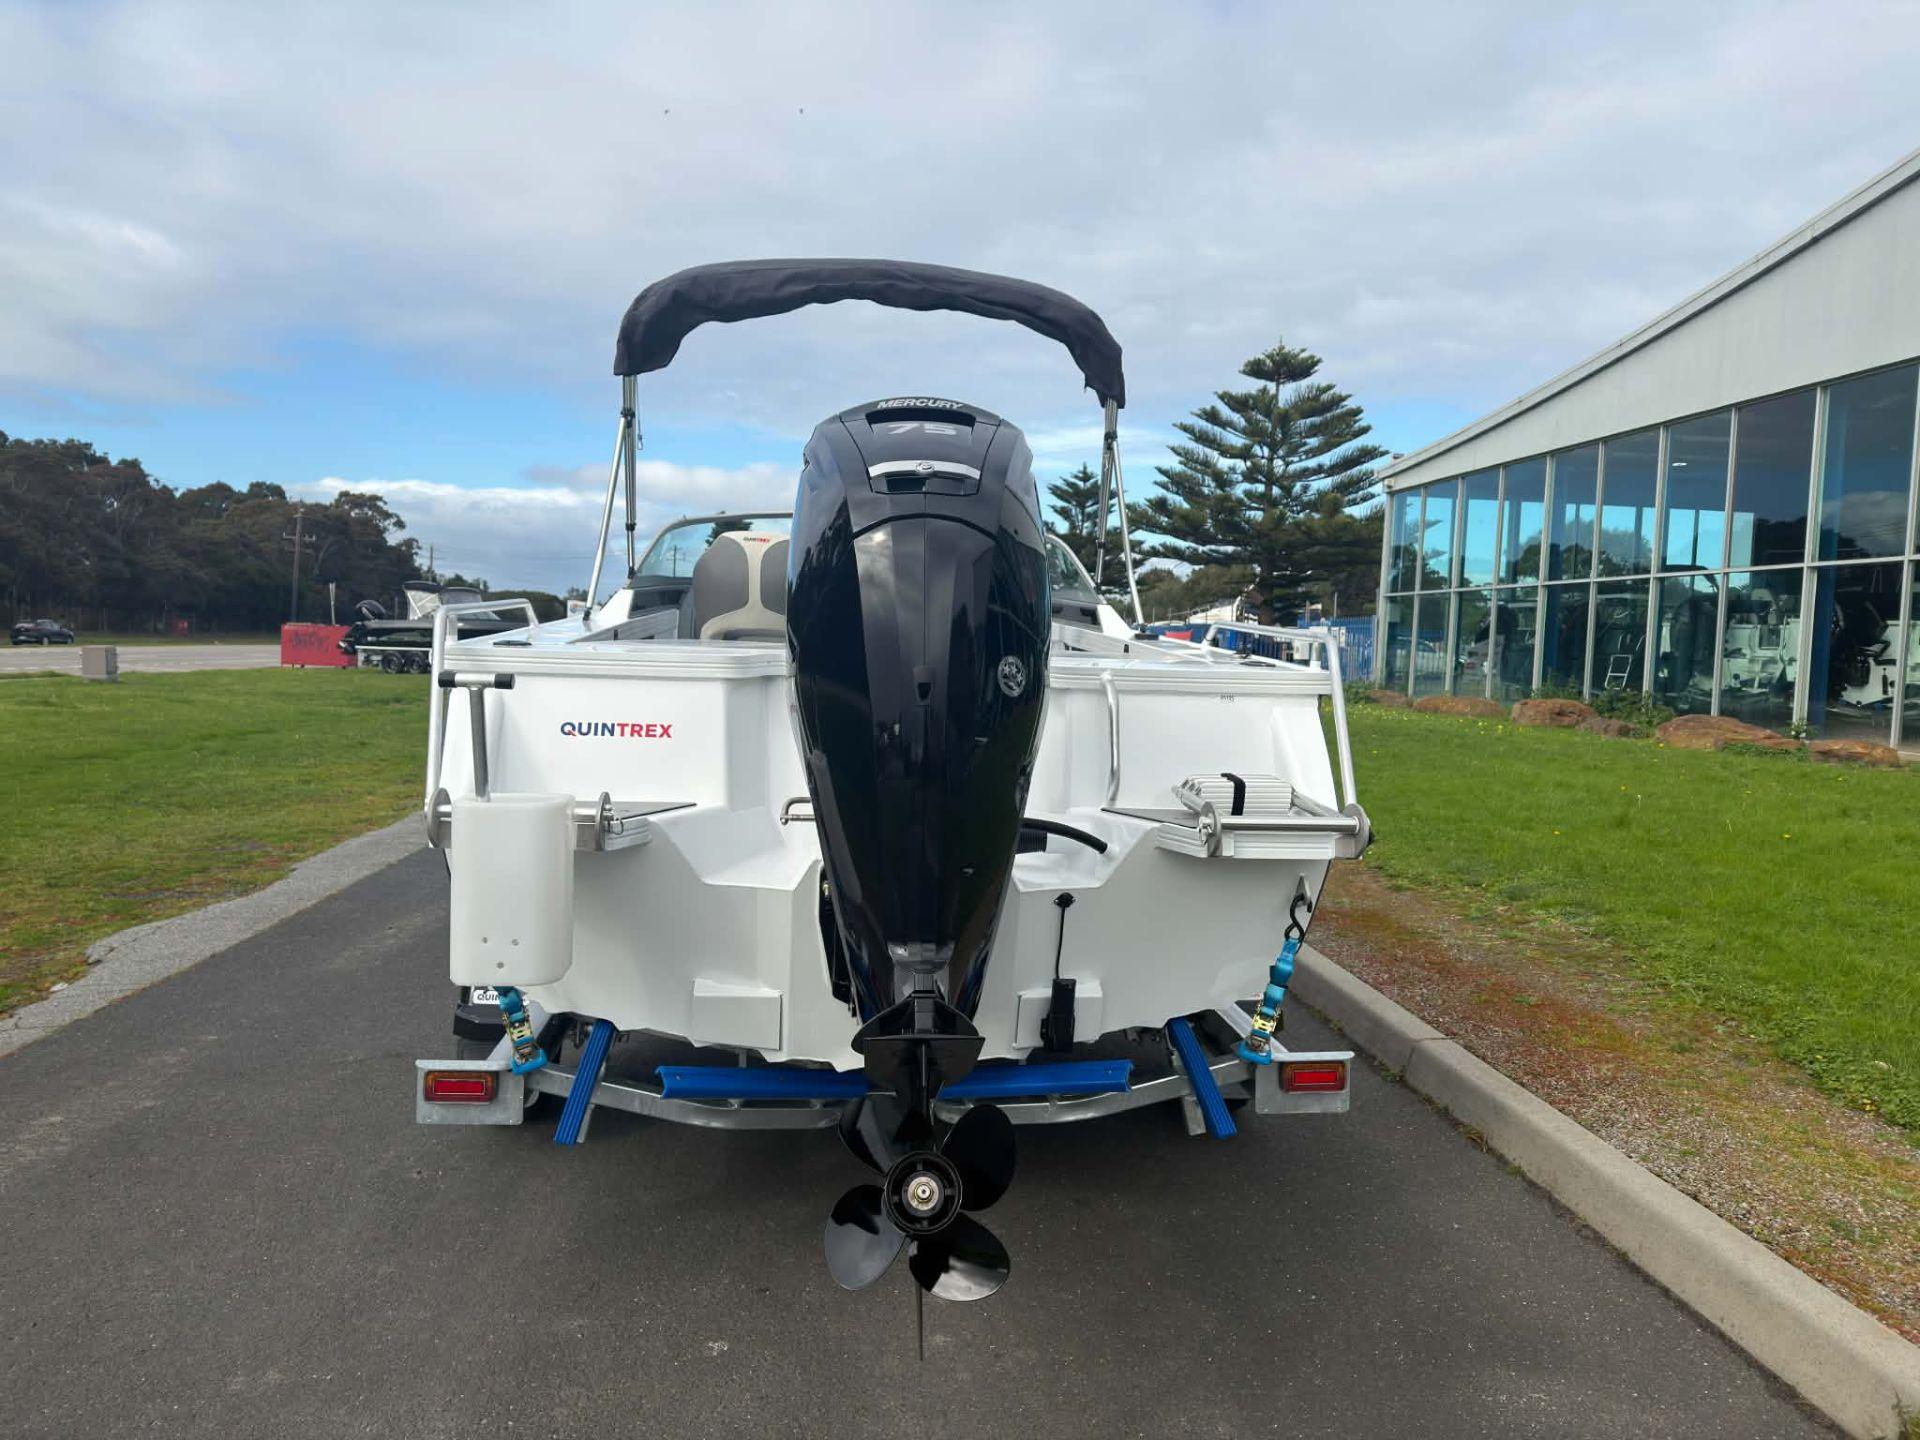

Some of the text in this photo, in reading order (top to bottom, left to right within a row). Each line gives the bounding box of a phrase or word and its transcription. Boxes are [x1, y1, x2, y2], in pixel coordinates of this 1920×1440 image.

[877, 398, 964, 409] MERCURY
[887, 423, 957, 435] 75
[560, 721, 673, 738] QUINTREX
